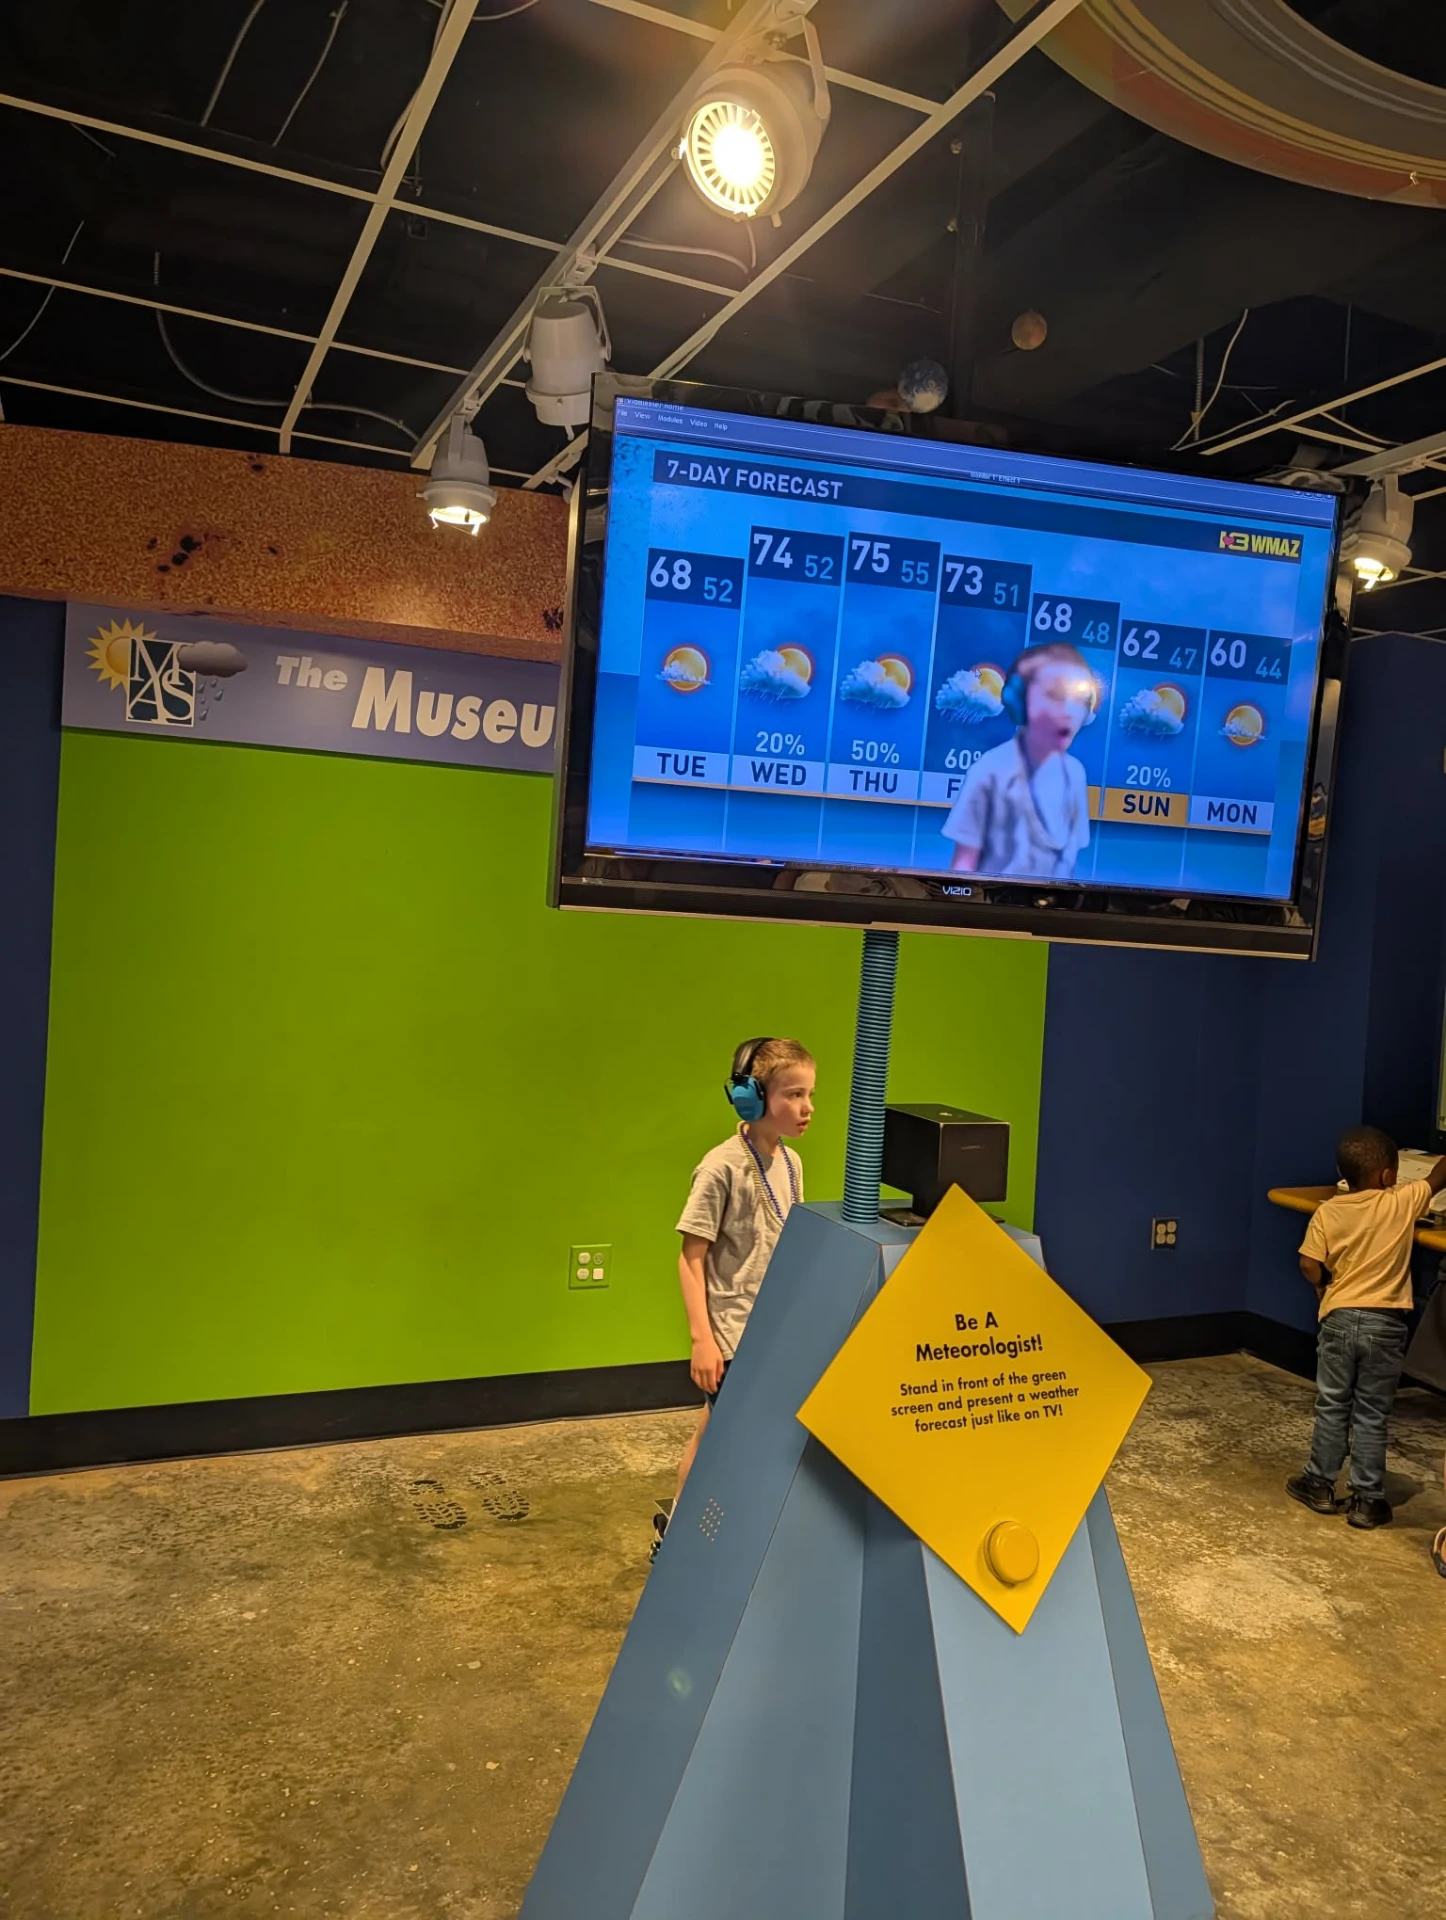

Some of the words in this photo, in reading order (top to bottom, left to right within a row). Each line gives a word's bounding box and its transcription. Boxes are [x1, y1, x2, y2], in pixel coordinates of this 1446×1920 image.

[634, 412, 651, 420] View
[658, 414, 683, 425] Modules
[690, 419, 708, 428] Video
[714, 422, 728, 431] Help
[667, 459, 731, 485] 7-DAY
[735, 468, 843, 500] FORECAST
[753, 533, 793, 569] 74
[804, 555, 834, 580] 52
[1251, 534, 1301, 558] WMAZ
[852, 539, 891, 573] 75
[901, 561, 930, 585] 55
[650, 555, 692, 590] 68
[703, 577, 734, 603] 52
[945, 561, 983, 596] 73
[993, 582, 1019, 607] 51
[1034, 601, 1072, 633] 68
[1082, 619, 1111, 645] 48
[1122, 628, 1159, 660] 62
[1169, 647, 1198, 670] 47
[1210, 638, 1246, 668] 60
[1255, 656, 1283, 680] 44
[275, 655, 348, 692] The
[351, 665, 557, 749] Museu
[755, 731, 805, 755] 20%
[852, 740, 900, 764] 50%
[657, 752, 707, 778] TUE
[750, 760, 807, 786] WED
[1126, 765, 1171, 788] 20%
[849, 769, 899, 794] THU
[1122, 794, 1170, 817] SUN
[1206, 803, 1258, 825] MON
[942, 885, 972, 896] VIZIO
[955, 1313, 978, 1331] Be
[984, 1311, 999, 1329] A
[915, 1334, 1044, 1362] Meteorologist!
[900, 1380, 938, 1397] Stand
[942, 1379, 954, 1393] in
[958, 1376, 989, 1391] front
[993, 1373, 1005, 1387] of
[1008, 1371, 1028, 1386] the
[1032, 1370, 1067, 1386] green
[891, 1402, 933, 1417] screen
[938, 1396, 962, 1412] and
[967, 1393, 1013, 1411] present
[1017, 1392, 1025, 1403] a
[1029, 1385, 1079, 1402] weather
[915, 1414, 967, 1433] forecast
[971, 1412, 994, 1430] just
[997, 1408, 1020, 1424] like
[1024, 1409, 1040, 1420] on
[1043, 1404, 1064, 1419] TV!
